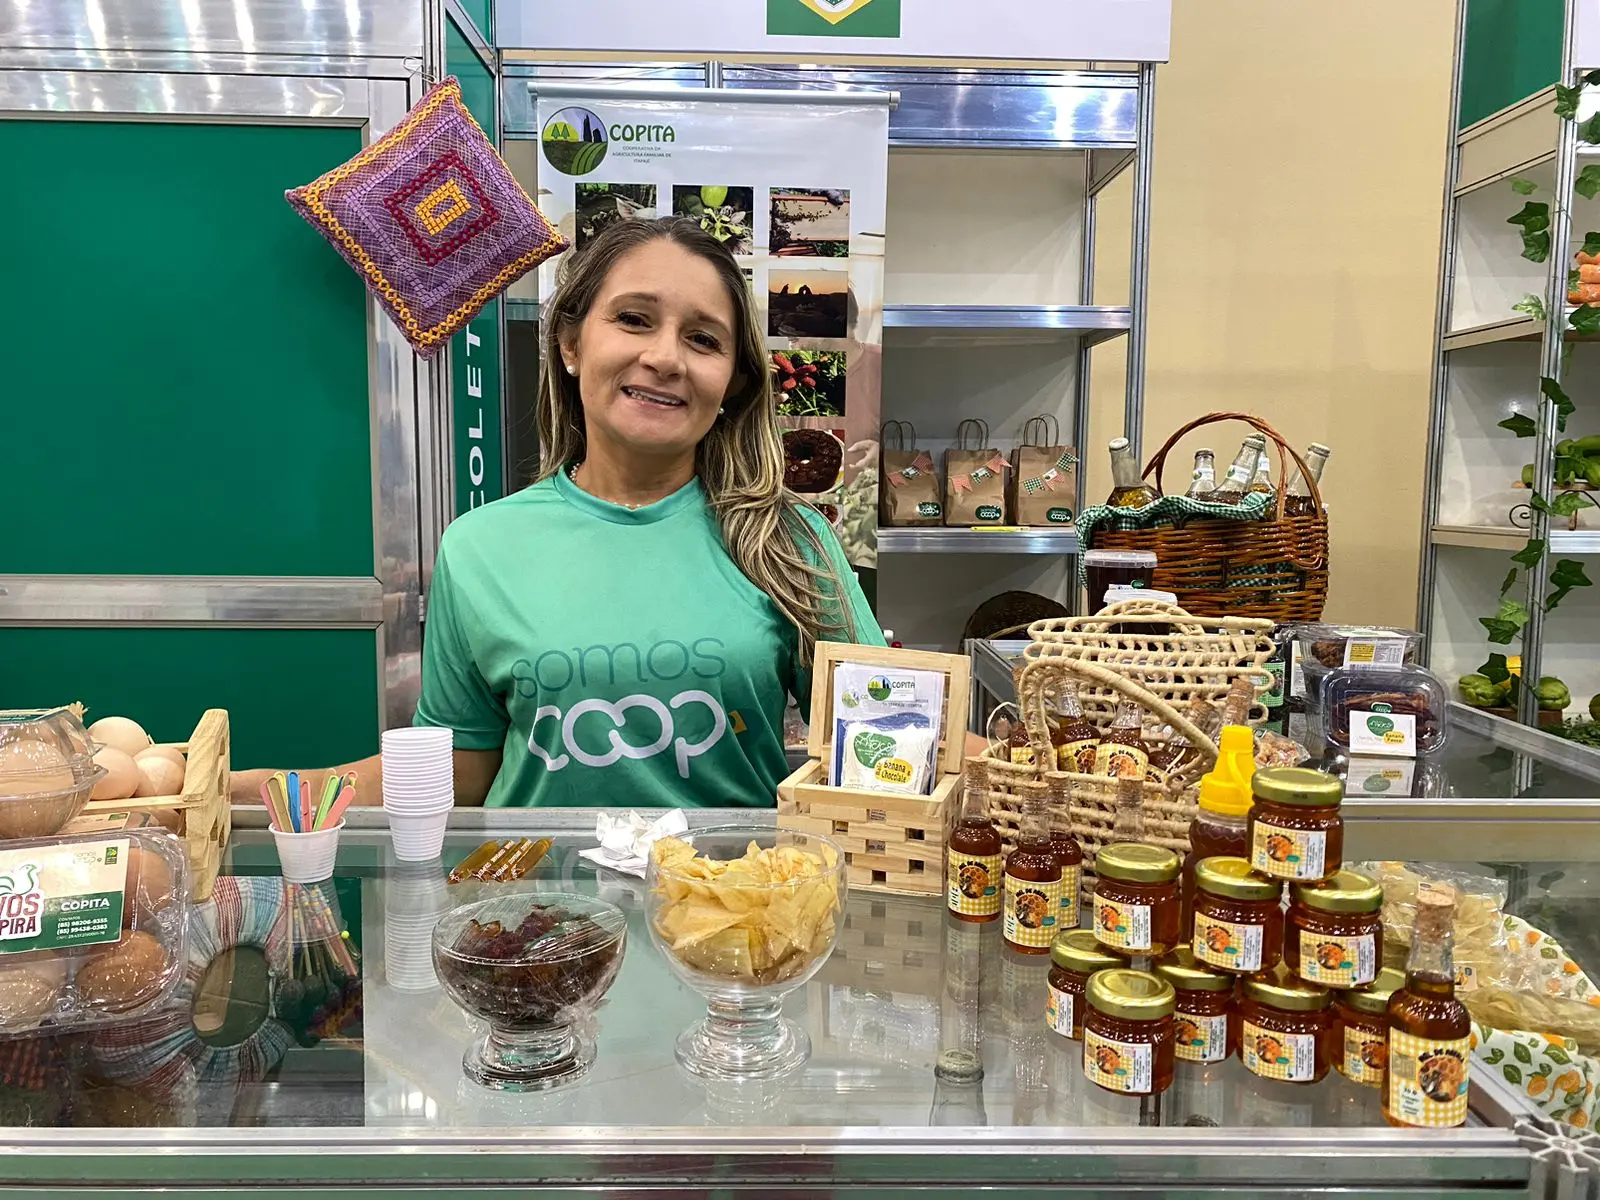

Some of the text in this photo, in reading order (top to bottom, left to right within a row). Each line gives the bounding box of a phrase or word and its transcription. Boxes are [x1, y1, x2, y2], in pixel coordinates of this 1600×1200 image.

[609, 123, 675, 142] COPITA
[510, 637, 726, 699] somos
[892, 681, 915, 689] COPITA
[528, 689, 726, 779] coop
[60, 897, 110, 912] COPITA
